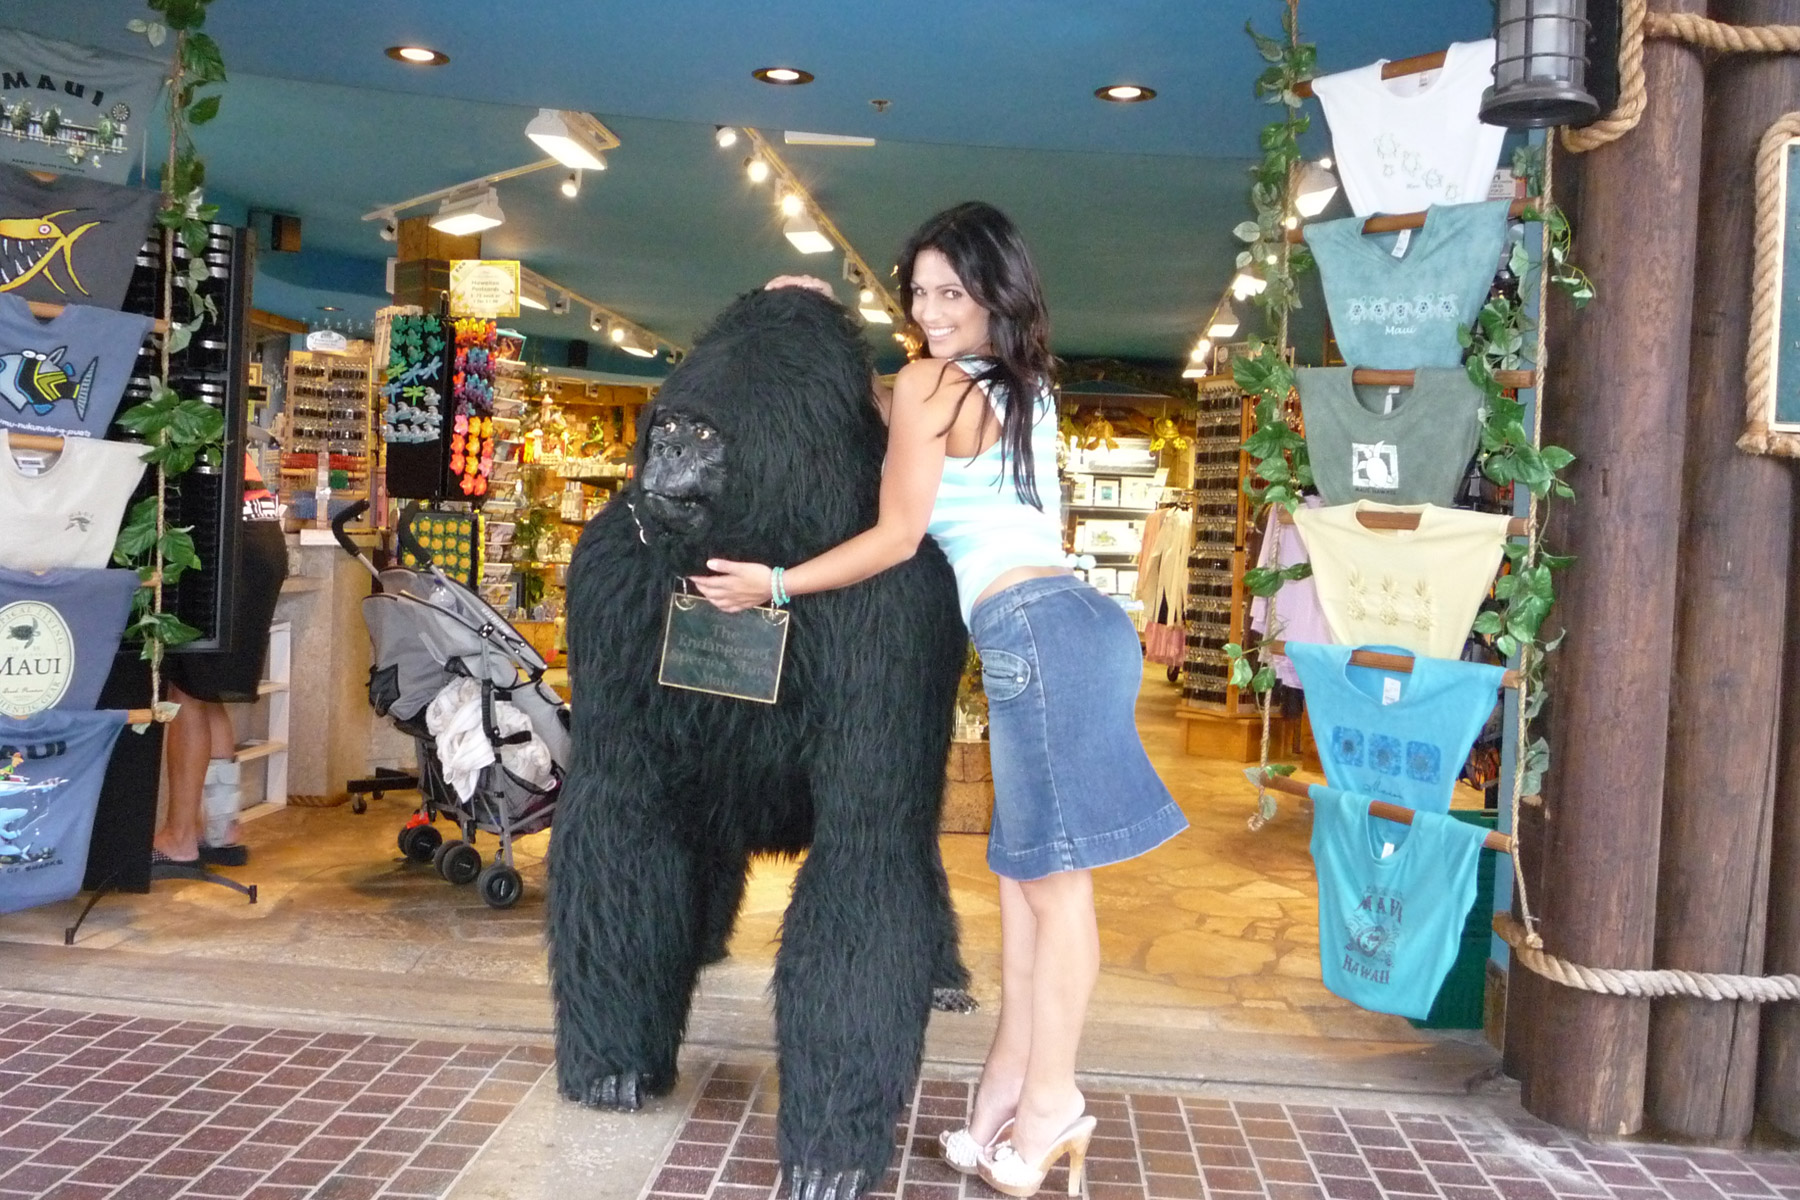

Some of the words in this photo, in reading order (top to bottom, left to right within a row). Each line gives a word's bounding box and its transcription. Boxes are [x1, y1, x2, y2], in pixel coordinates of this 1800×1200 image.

[2, 72, 104, 106] MAUI
[1385, 325, 1417, 336] Maui
[0, 605, 34, 628] PICAL
[37, 607, 64, 645] LIVING
[712, 623, 741, 639] The
[678, 633, 770, 660] Endangered
[670, 649, 727, 671] Species
[41, 681, 60, 704] GEAR
[0, 741, 67, 759] AUI
[1342, 953, 1390, 984] HAWAII
